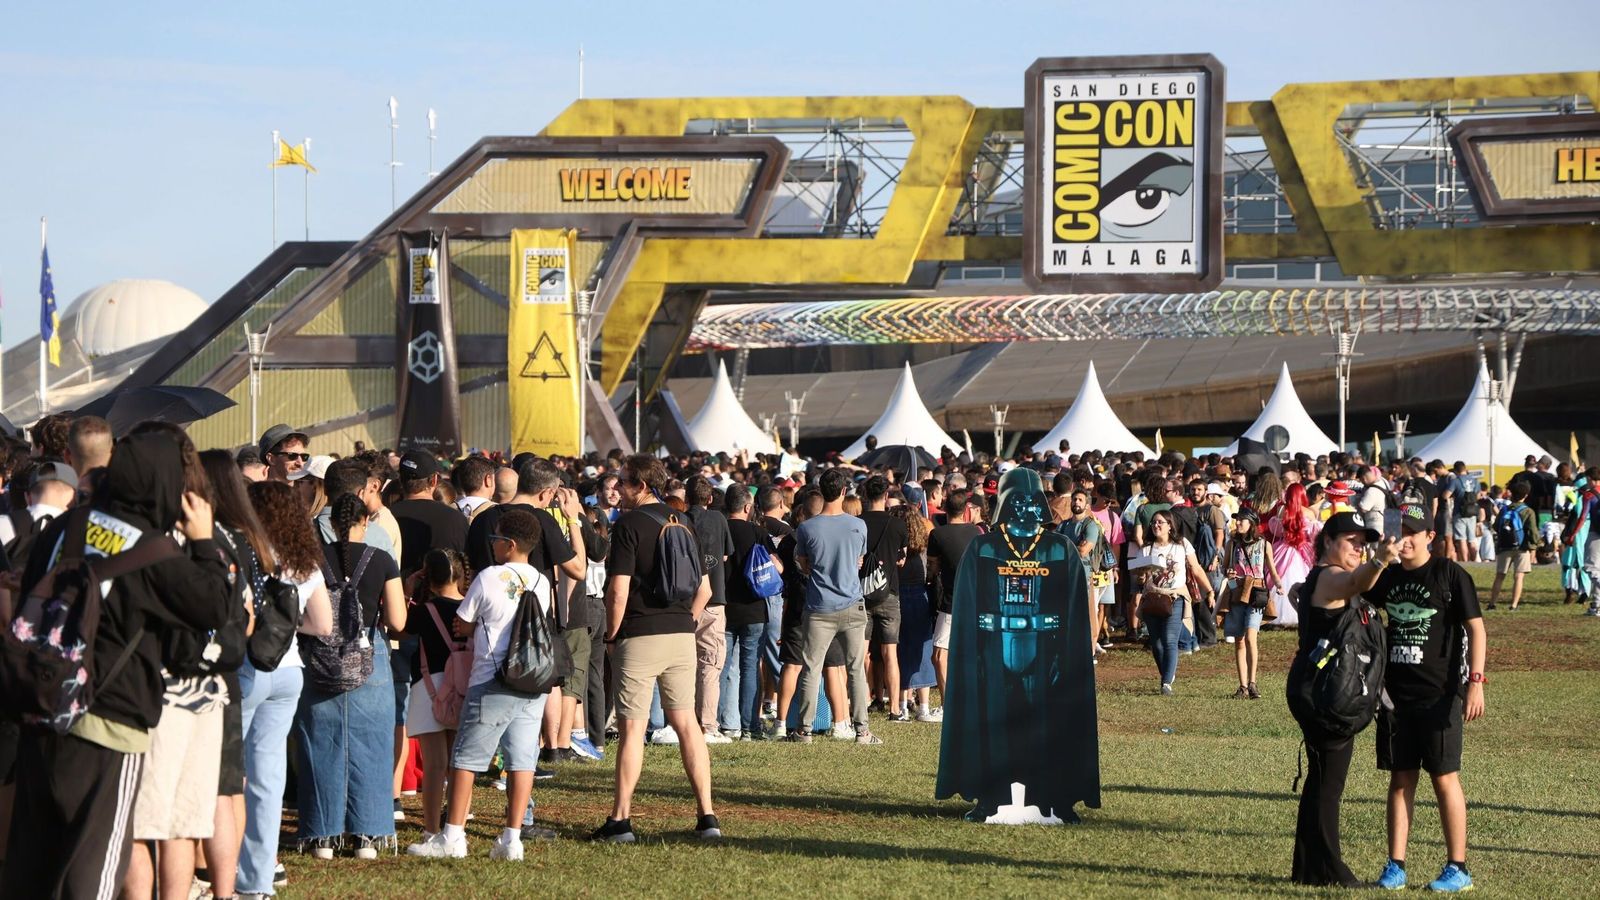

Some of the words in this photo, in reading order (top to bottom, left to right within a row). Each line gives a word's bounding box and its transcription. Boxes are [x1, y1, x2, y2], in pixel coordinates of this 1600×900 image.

[1053, 83, 1097, 98] SAN
[1119, 81, 1196, 96] DIEGO
[1104, 100, 1194, 147] CON
[1055, 102, 1101, 241] COMIC
[1556, 148, 1600, 182] HE
[560, 167, 692, 201] WELCOME
[540, 255, 565, 268] CON
[1053, 246, 1192, 266] MÁLAGA
[413, 255, 424, 295] COMIC
[527, 255, 540, 295] COMIC
[86, 523, 127, 555] CON
[1391, 645, 1422, 656] STAR
